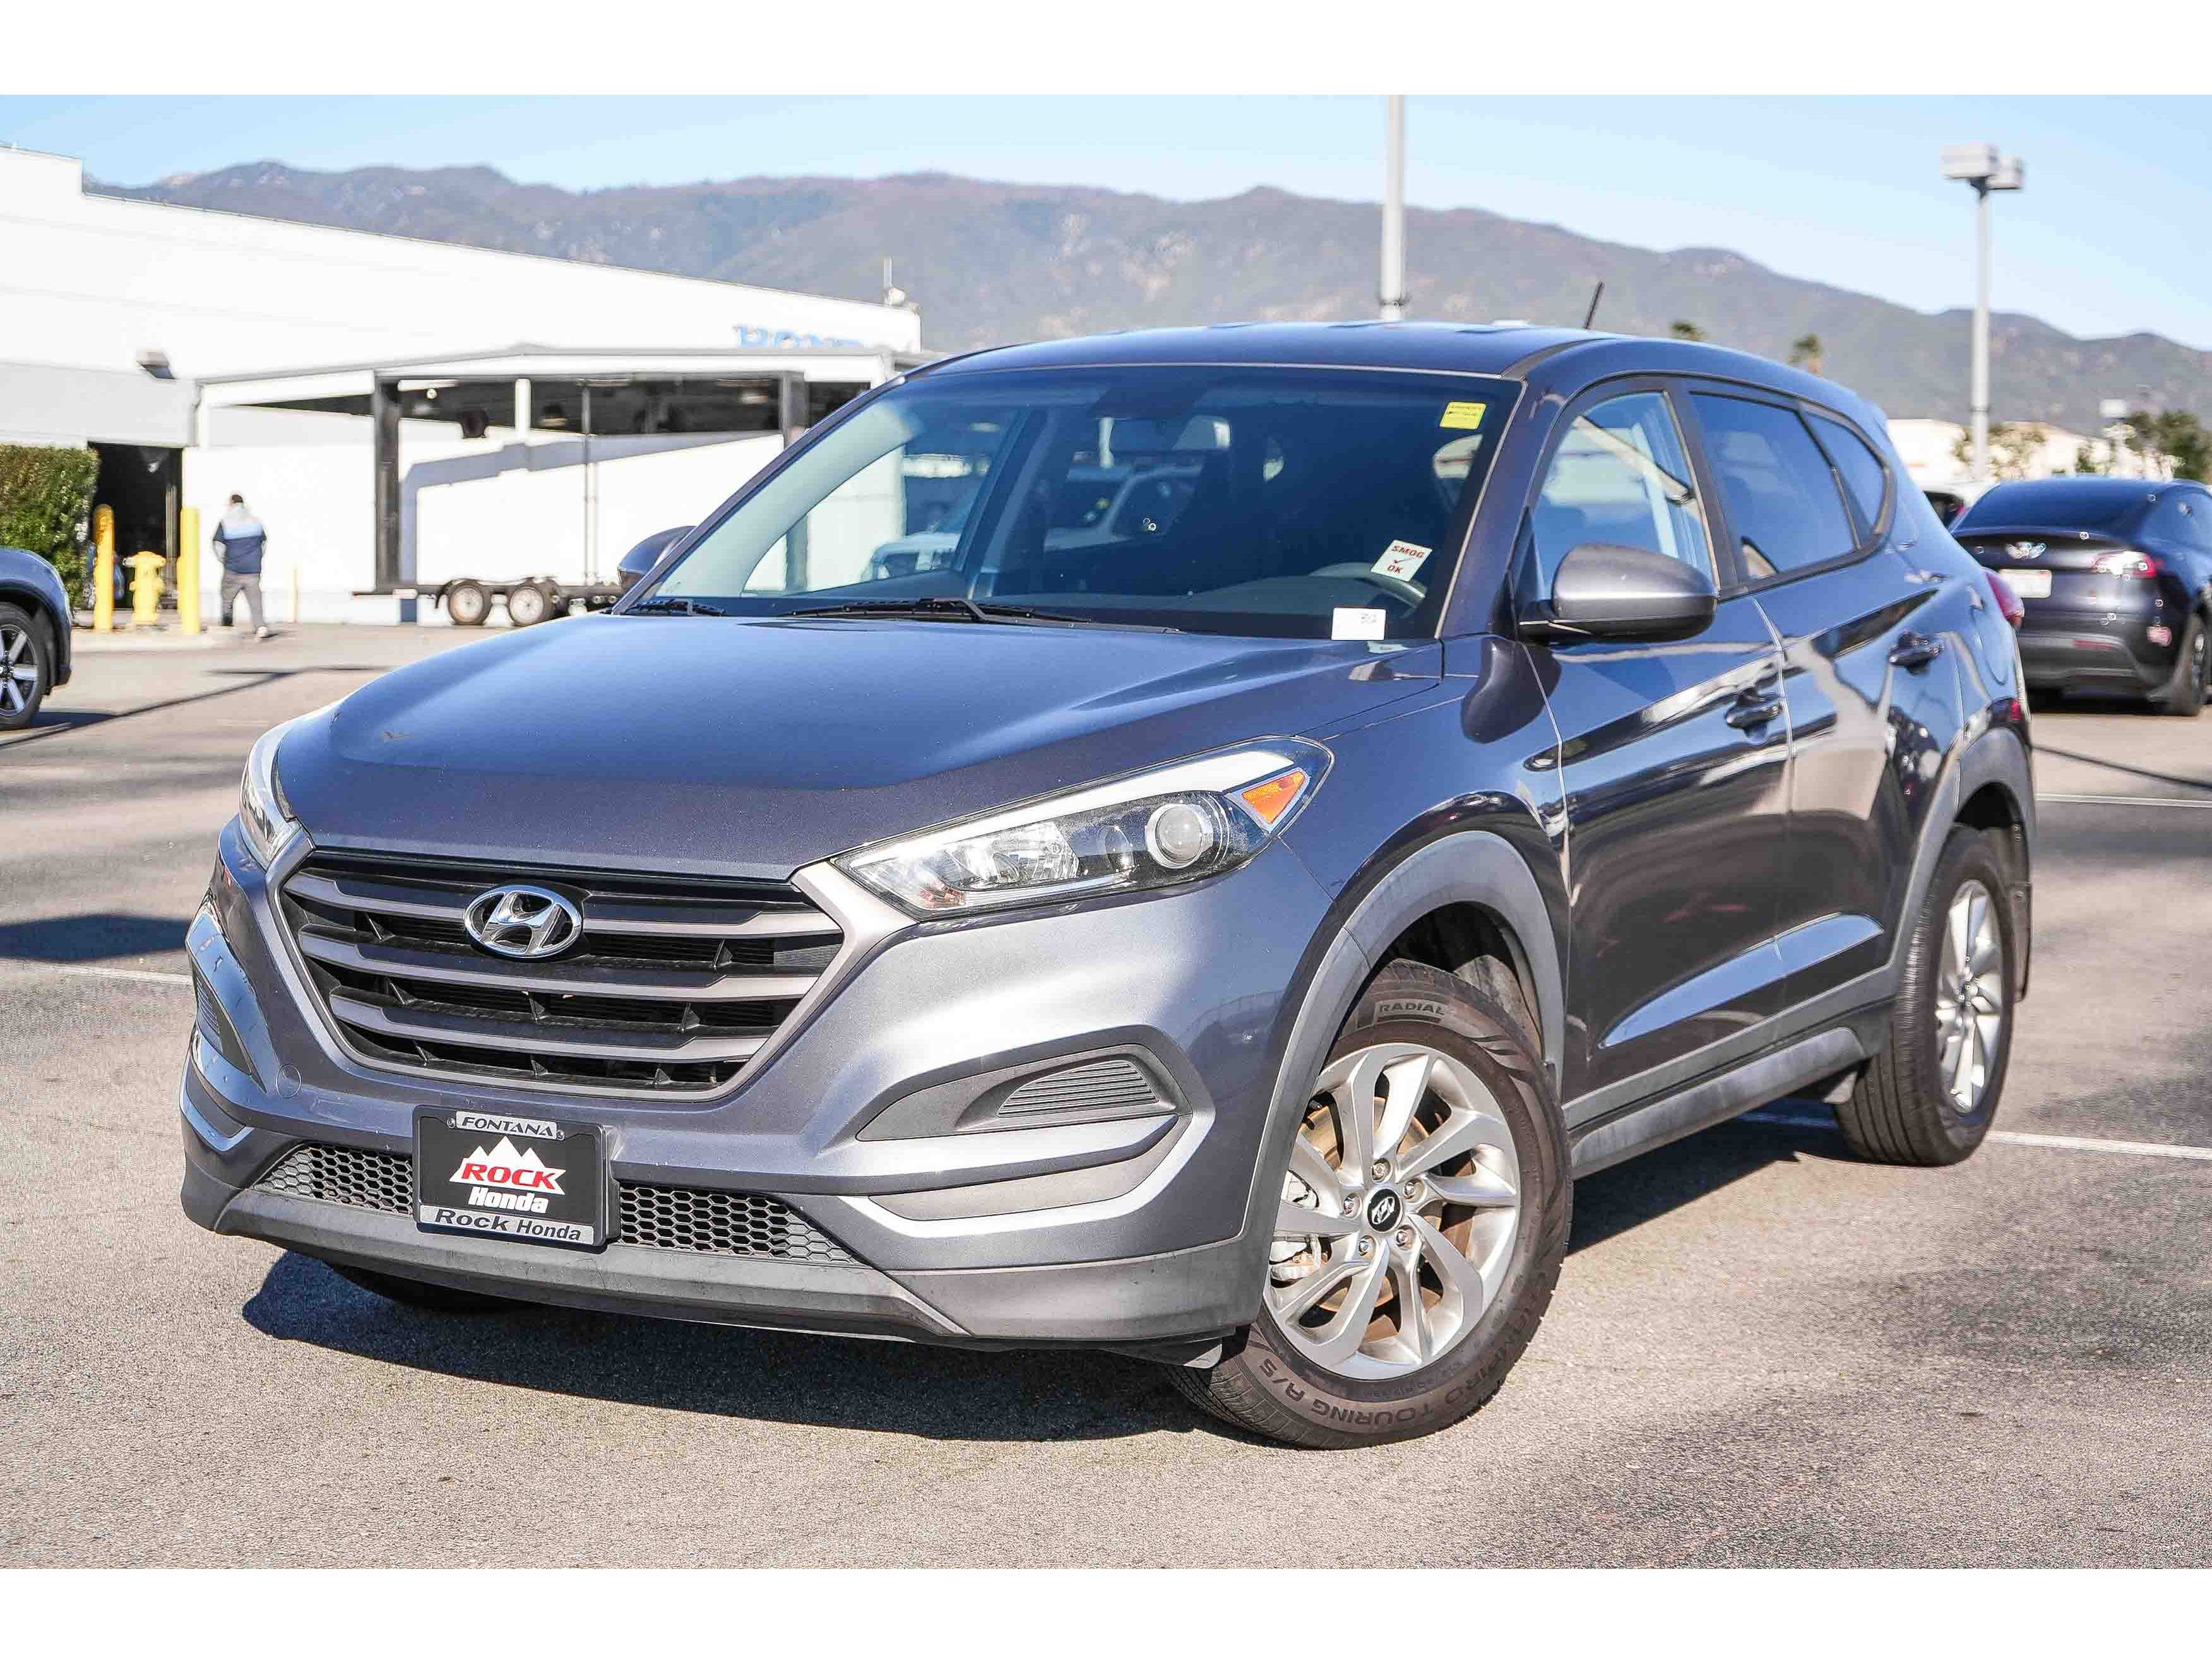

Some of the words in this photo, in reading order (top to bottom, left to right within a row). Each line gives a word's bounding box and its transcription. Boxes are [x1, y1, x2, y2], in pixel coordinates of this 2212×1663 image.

[1392, 545, 1425, 559] SMOG
[1387, 565, 1403, 574] OK
[1379, 1002, 1445, 1015] RADIAL
[461, 1116, 554, 1137] FONTANA
[461, 1163, 556, 1190] ROCK
[468, 1186, 549, 1214] Honda
[434, 1209, 512, 1231] Rock
[515, 1219, 581, 1241] Honda
[1258, 1357, 1308, 1403] A/S
[1311, 1397, 1434, 1426] TOURING
